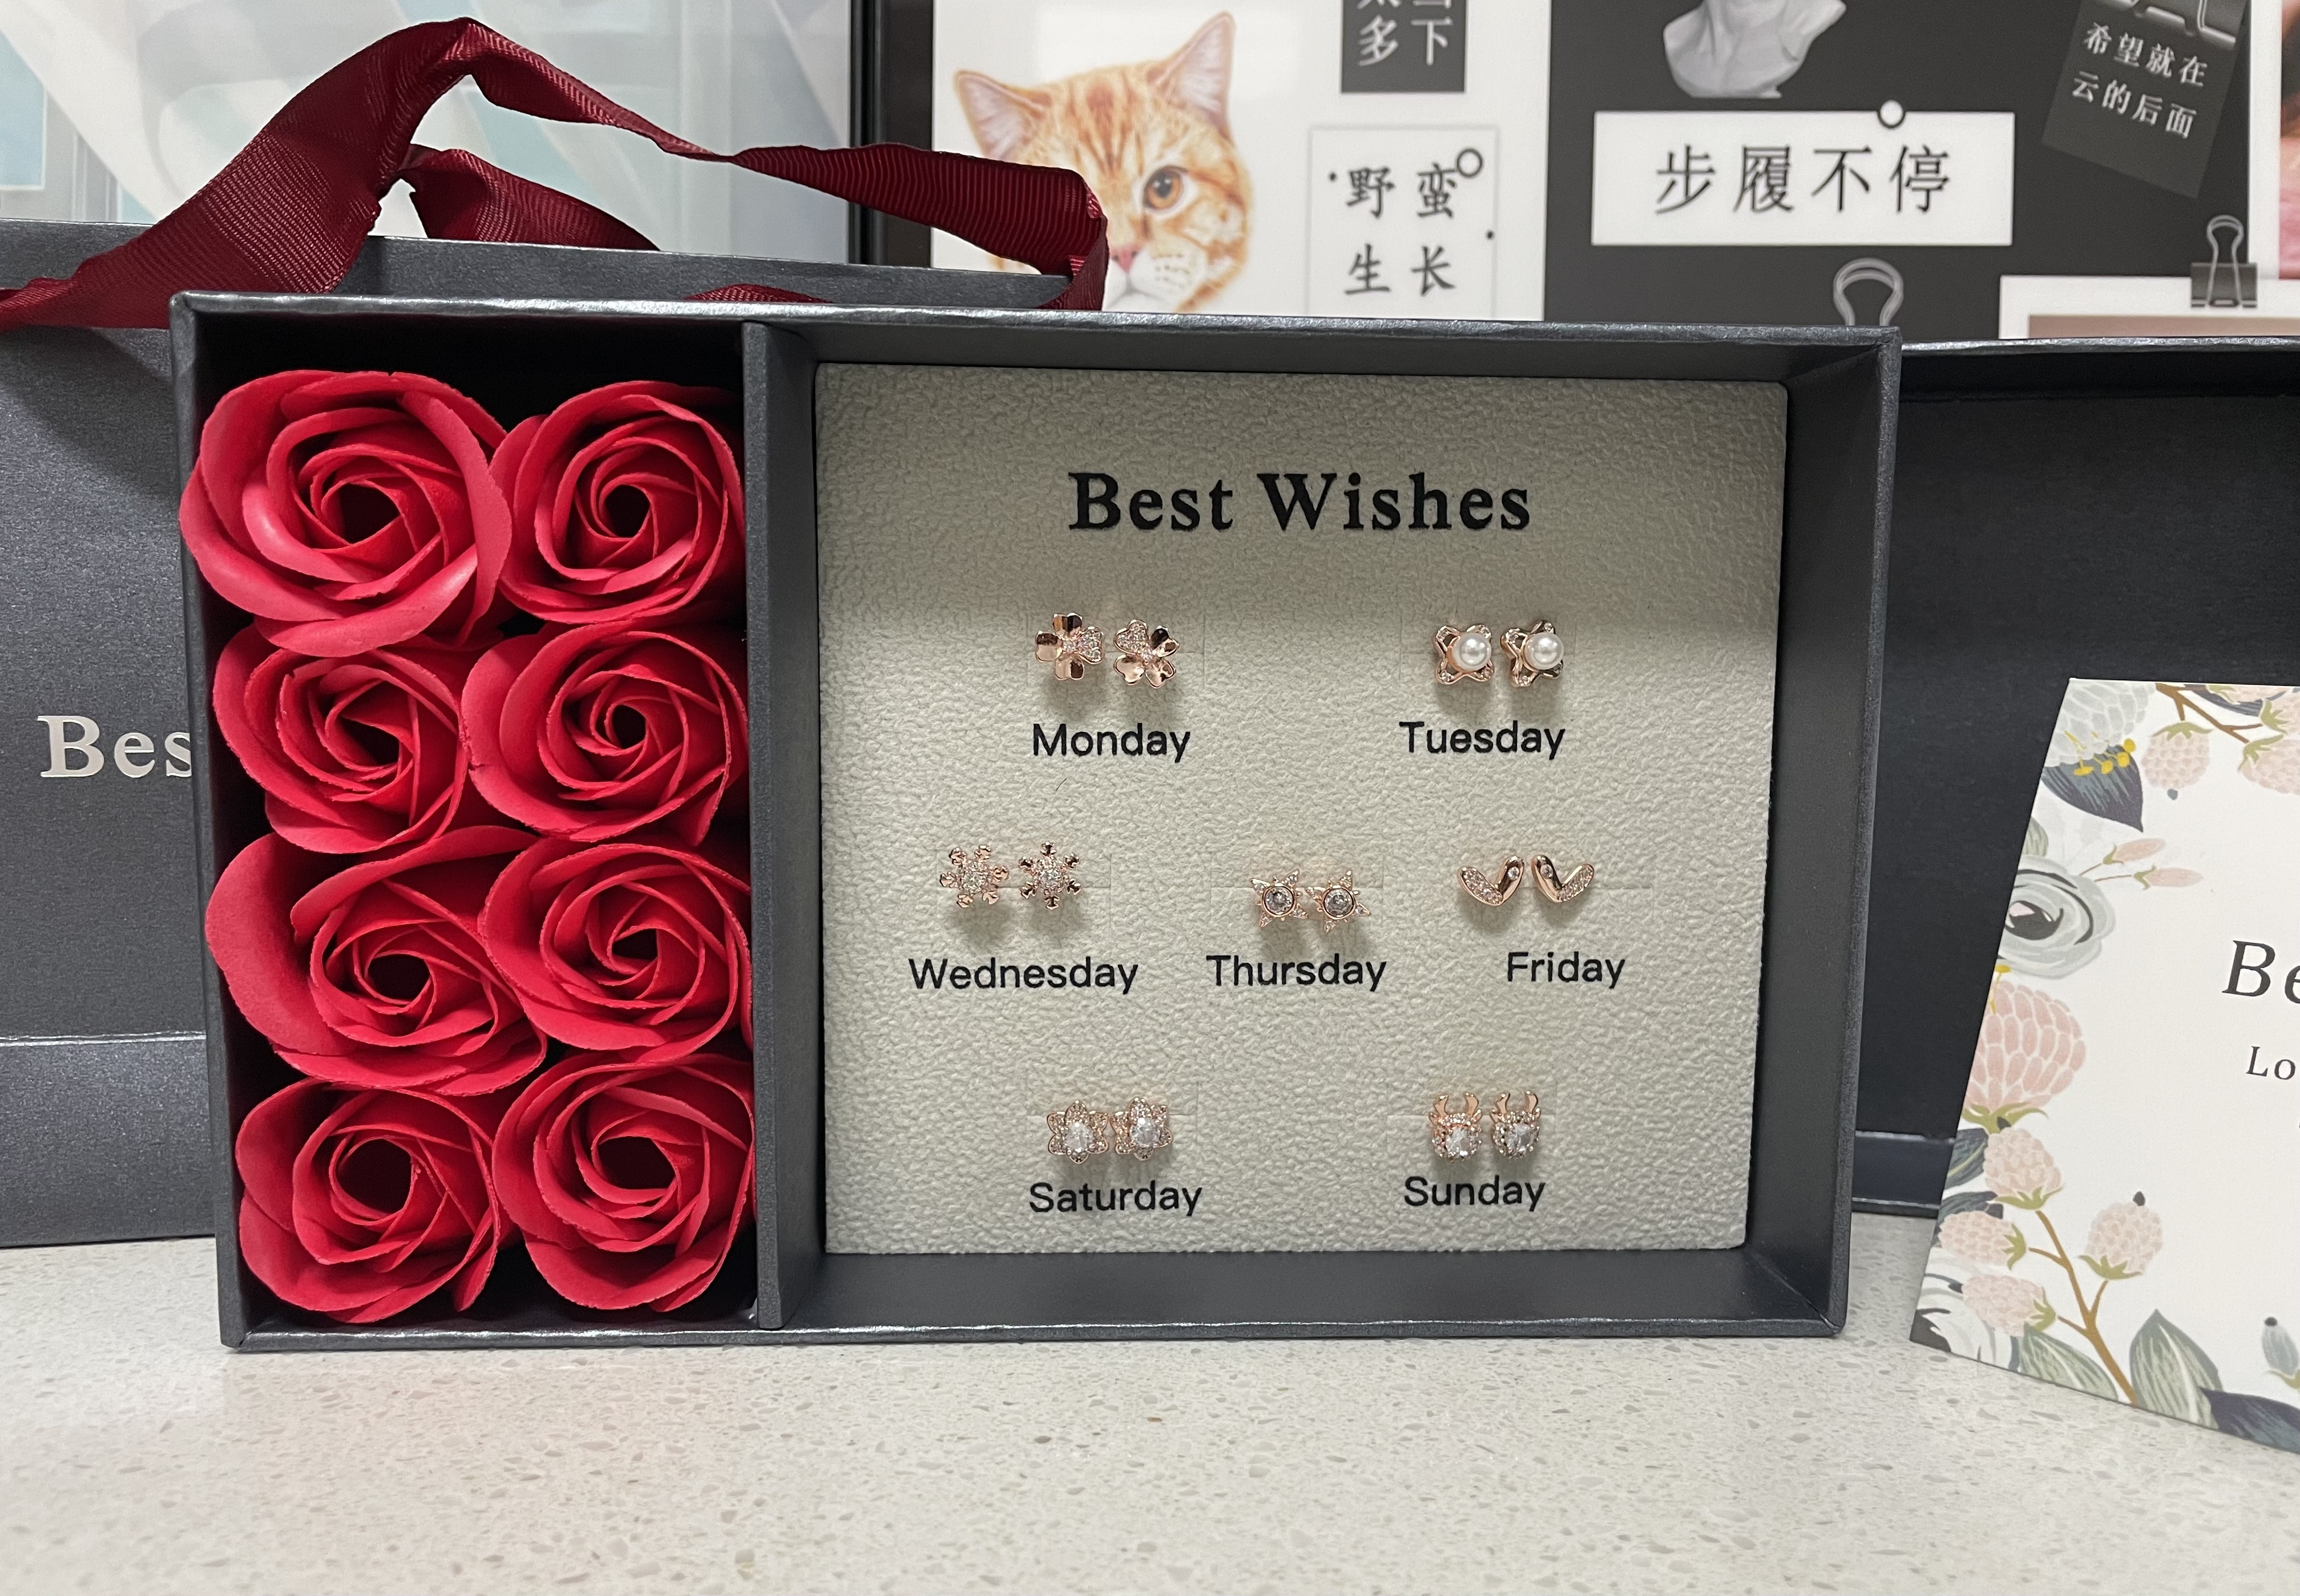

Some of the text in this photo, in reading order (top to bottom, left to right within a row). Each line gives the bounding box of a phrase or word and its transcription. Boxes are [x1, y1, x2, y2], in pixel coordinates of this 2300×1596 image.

[2083, 22, 2208, 87] 希望就在
[2072, 70, 2197, 139] 云的后面
[1346, 162, 1457, 219] 野蛮
[1655, 143, 1951, 214] 步履不停
[1344, 243, 1456, 297] 生长
[1068, 471, 1531, 532] Best Wishes
[37, 715, 192, 778] Bes
[1032, 722, 1191, 763] Monday
[1399, 720, 1566, 760] Tuesday
[908, 956, 1139, 995] Wednesday
[1205, 953, 1387, 992] Thursday
[1507, 951, 1626, 989] Friday
[2245, 1045, 2296, 1080] Lo
[1029, 1179, 1203, 1216] Saturday
[1404, 1174, 1546, 1211] Sunday
